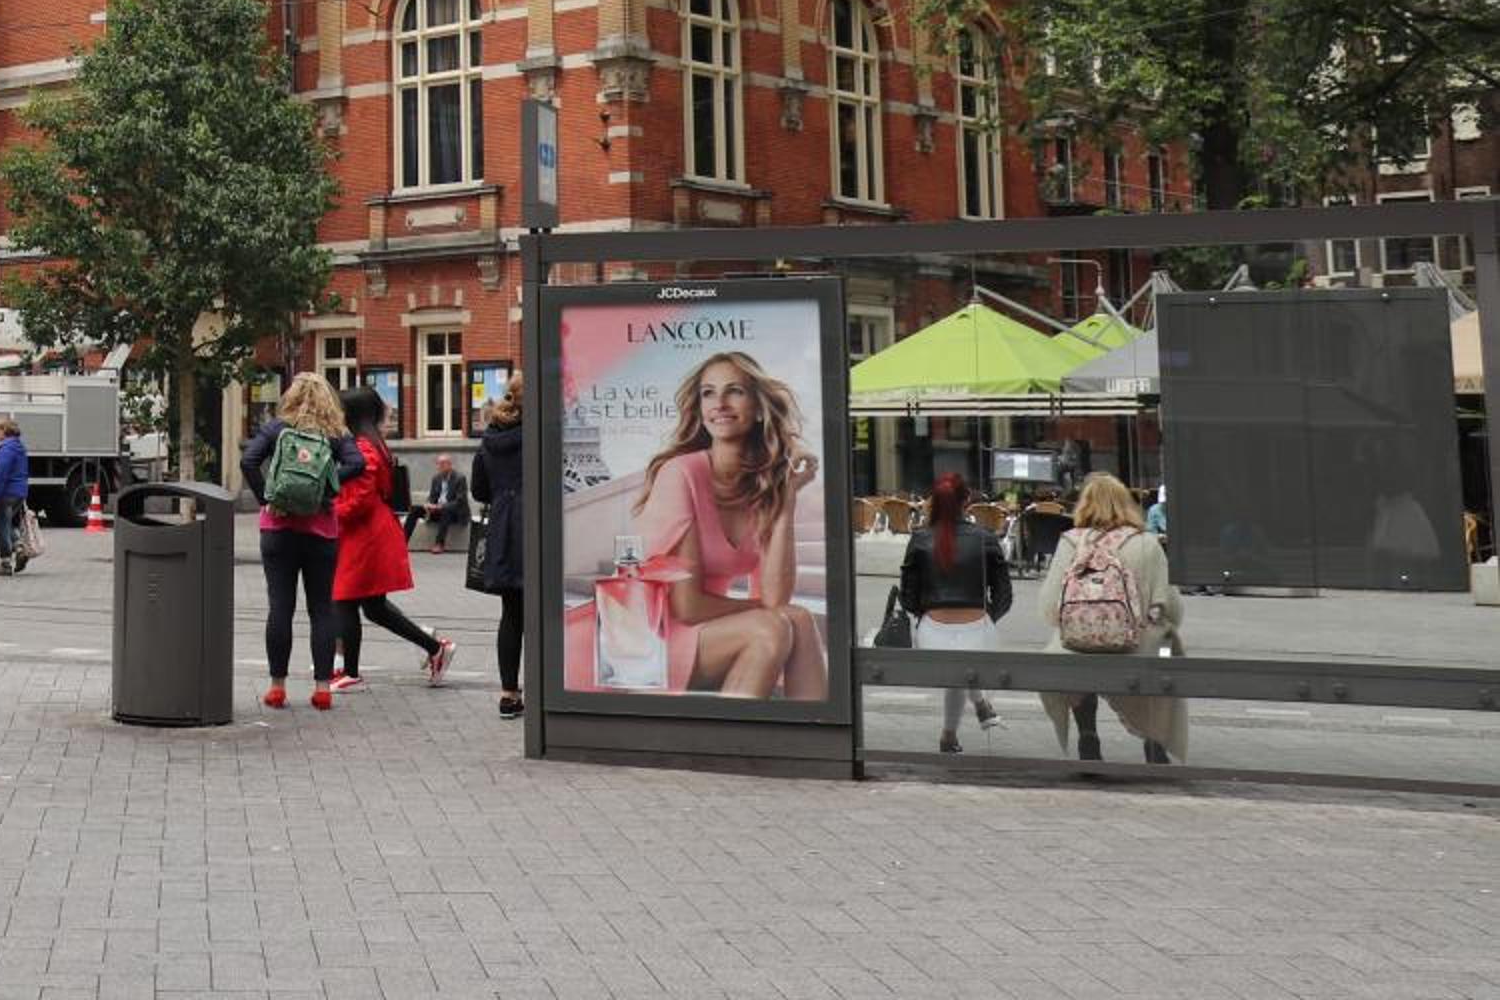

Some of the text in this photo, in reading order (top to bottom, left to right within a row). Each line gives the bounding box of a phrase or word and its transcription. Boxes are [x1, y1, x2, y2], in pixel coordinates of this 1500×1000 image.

[657, 286, 718, 299] JCDecaux
[592, 383, 659, 401] La vie
[575, 400, 677, 419] est belle
